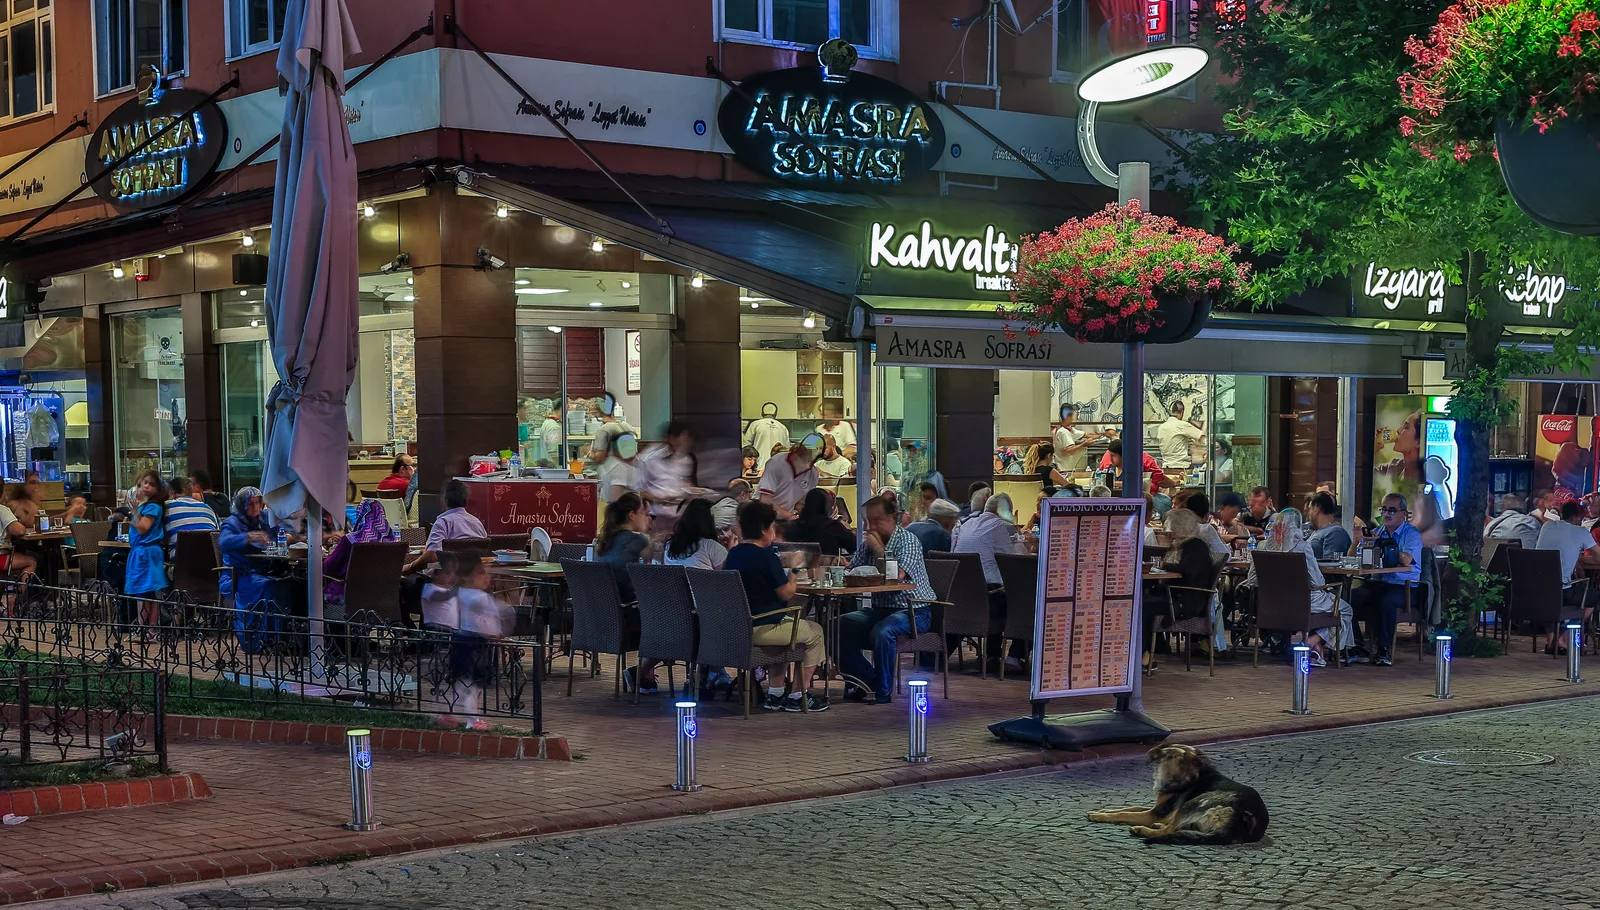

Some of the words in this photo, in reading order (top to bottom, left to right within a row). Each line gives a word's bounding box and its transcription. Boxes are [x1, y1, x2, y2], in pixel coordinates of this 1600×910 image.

[98, 112, 202, 162] AMASRA
[746, 93, 932, 143] AMASRA
[110, 156, 186, 198] SOFRASI
[773, 141, 905, 181] SOFRASI
[975, 273, 1019, 290] breakfa
[887, 331, 967, 359] AMASRA
[984, 334, 1052, 360] SOFRASI
[500, 502, 546, 525] Amasra
[548, 502, 585, 527] Sofrası
